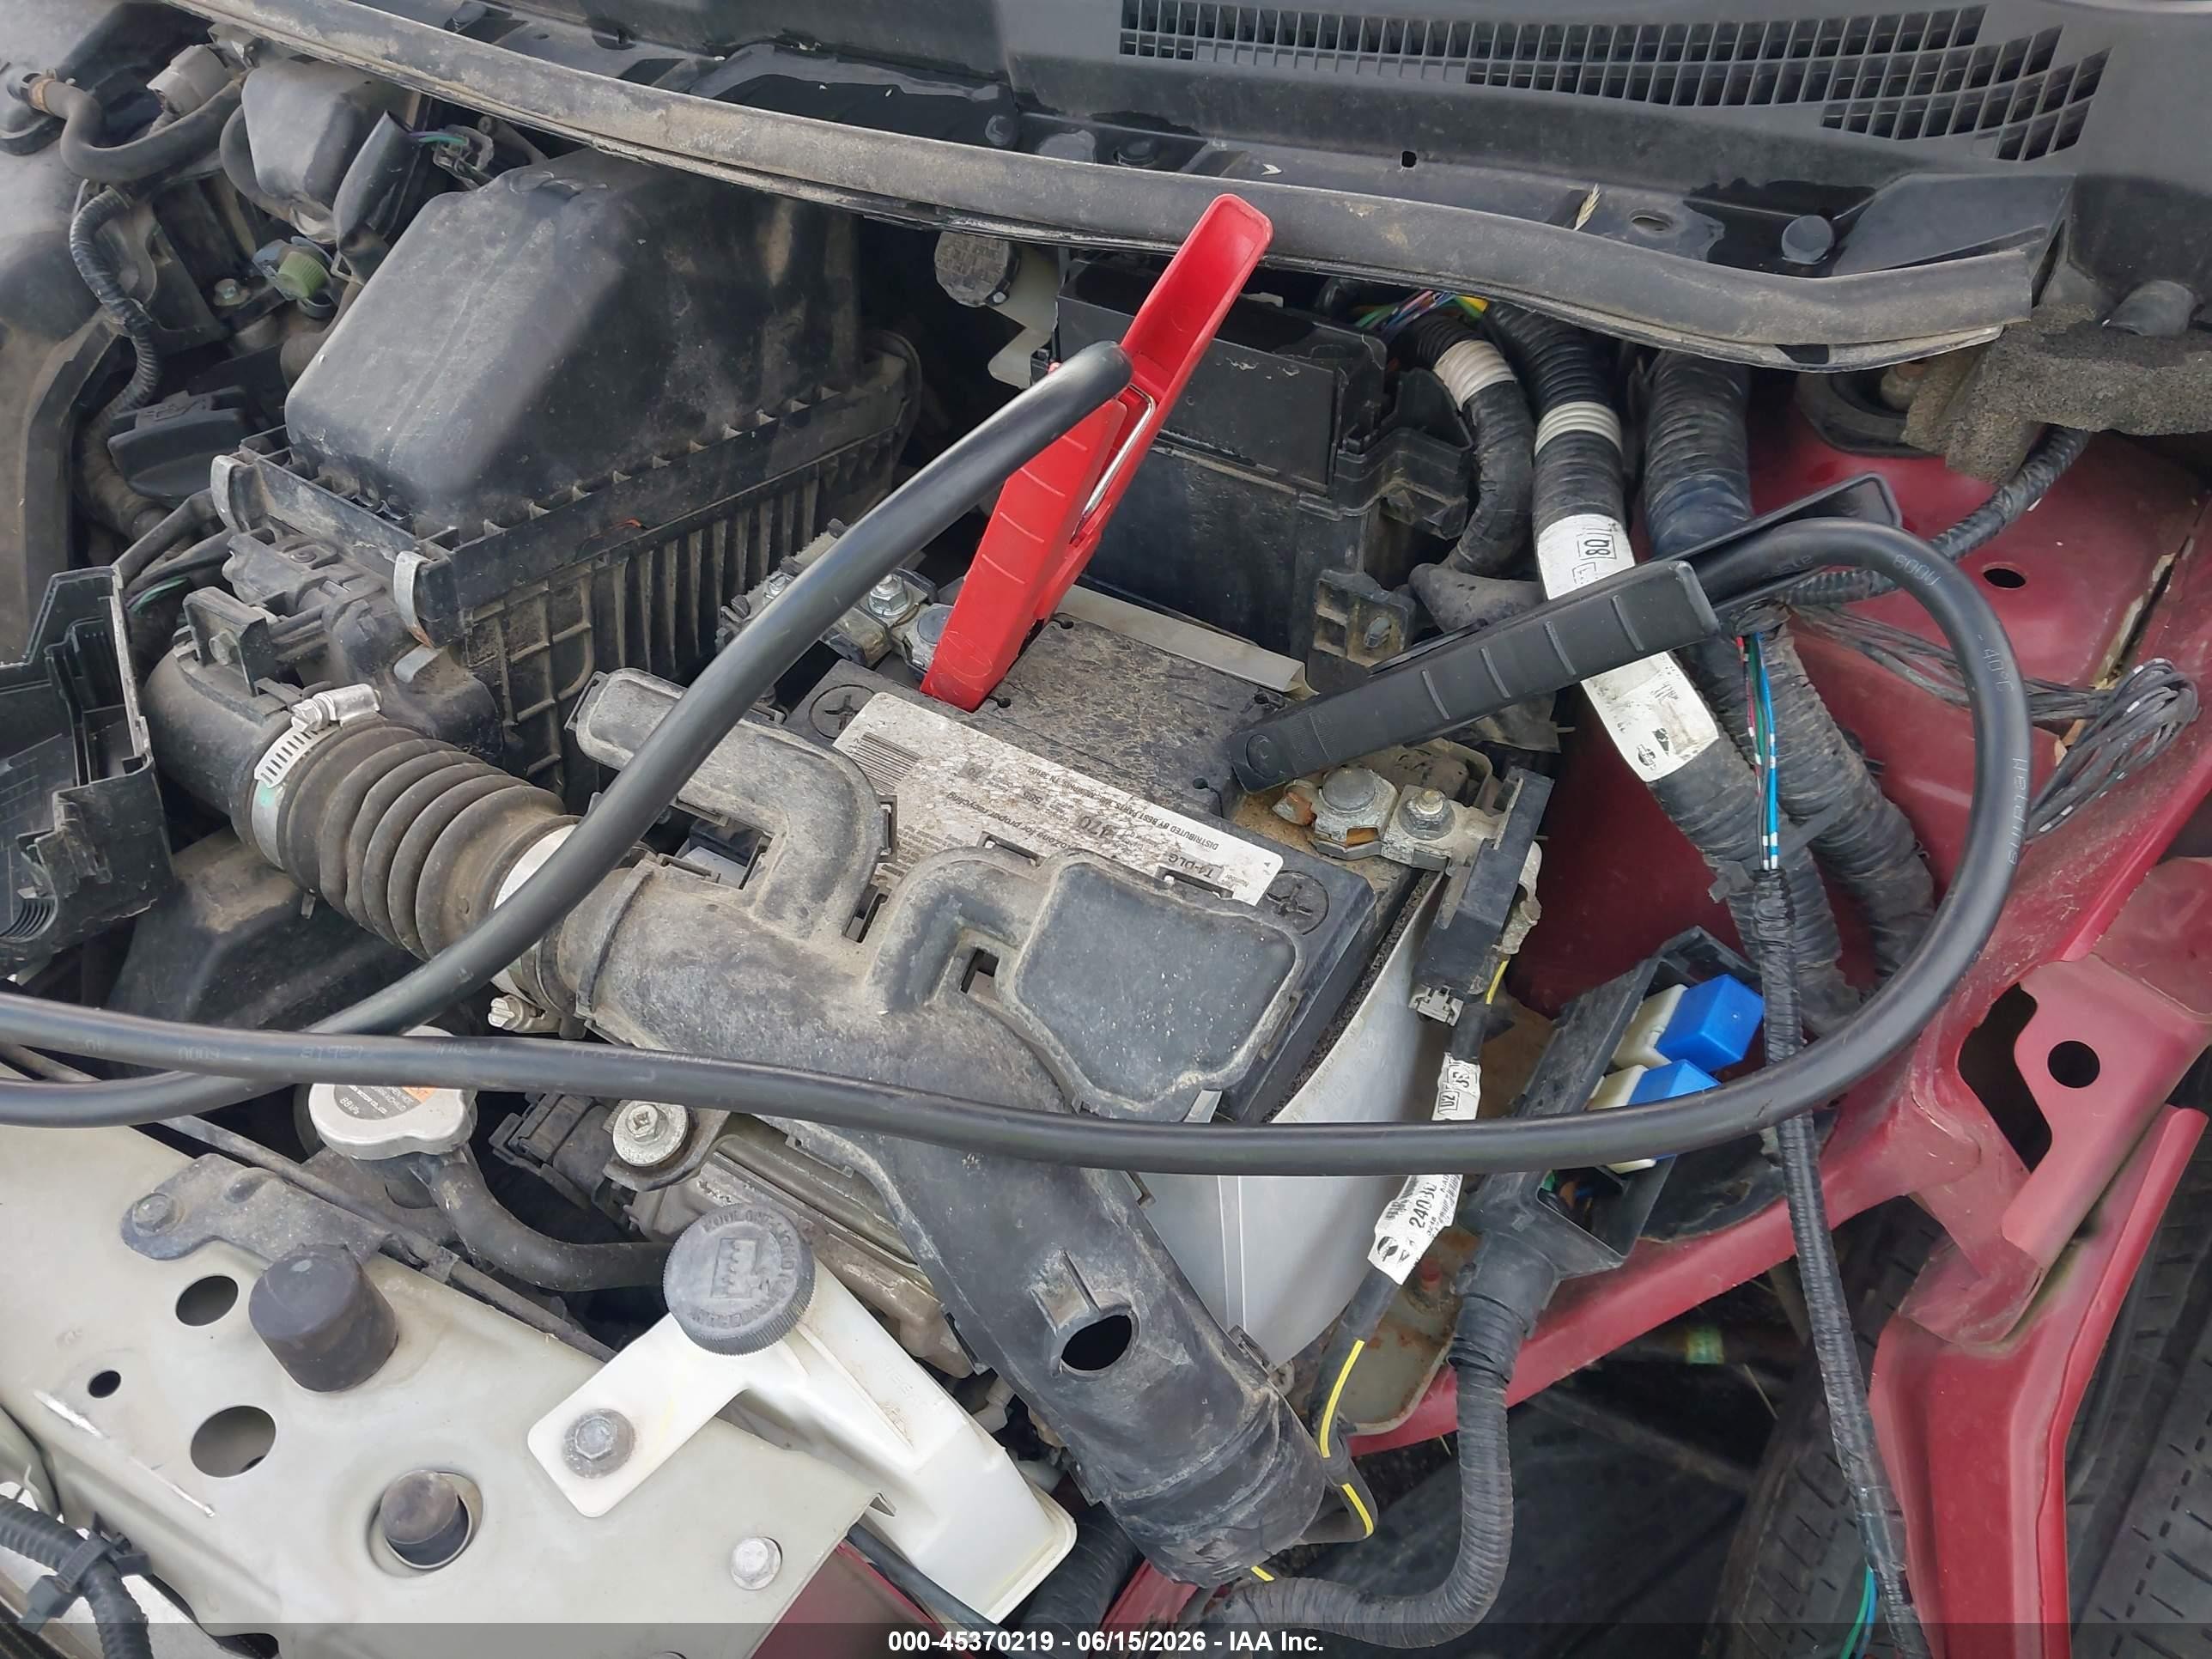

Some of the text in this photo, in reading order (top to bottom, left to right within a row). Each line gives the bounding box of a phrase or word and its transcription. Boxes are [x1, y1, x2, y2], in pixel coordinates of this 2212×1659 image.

[1048, 774, 1060, 784] TN
[945, 790, 989, 816] recycling
[2008, 757, 2029, 865] Welding
[987, 809, 1022, 830] proper
[1137, 811, 1159, 826] BEST
[1157, 819, 1170, 830] BY
[1019, 824, 1036, 836] for
[1169, 824, 1219, 850] DISTRIBUTED
